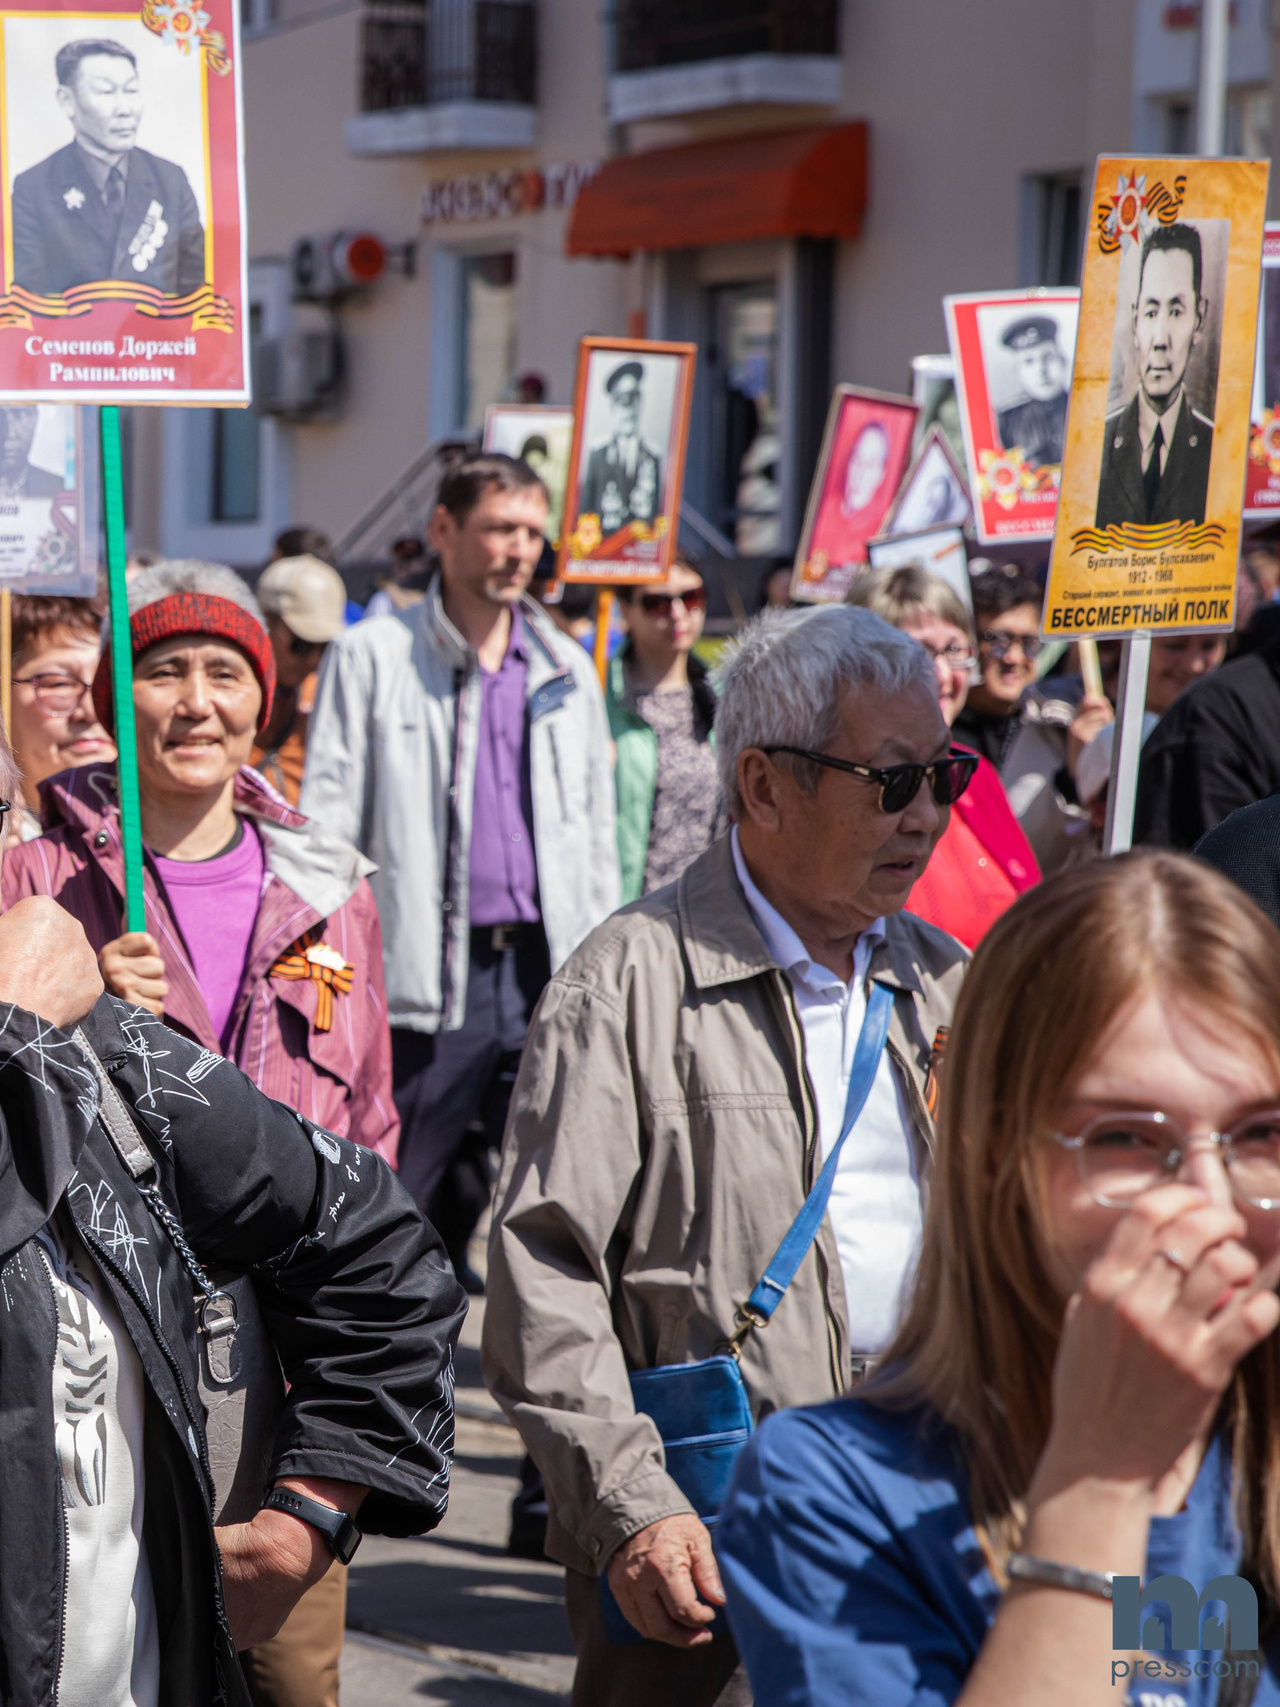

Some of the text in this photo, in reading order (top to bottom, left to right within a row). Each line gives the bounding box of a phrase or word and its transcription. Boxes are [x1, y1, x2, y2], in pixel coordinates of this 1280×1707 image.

[24, 335, 197, 360] Семенов Доржей
[48, 362, 176, 382] Рампилович
[1087, 553, 1129, 572] Булгатов
[1130, 552, 1157, 569] Борис
[1128, 570, 1147, 584] 1912
[1050, 598, 1231, 629] БЕССМЕРТНЫЙ ПОЛК
